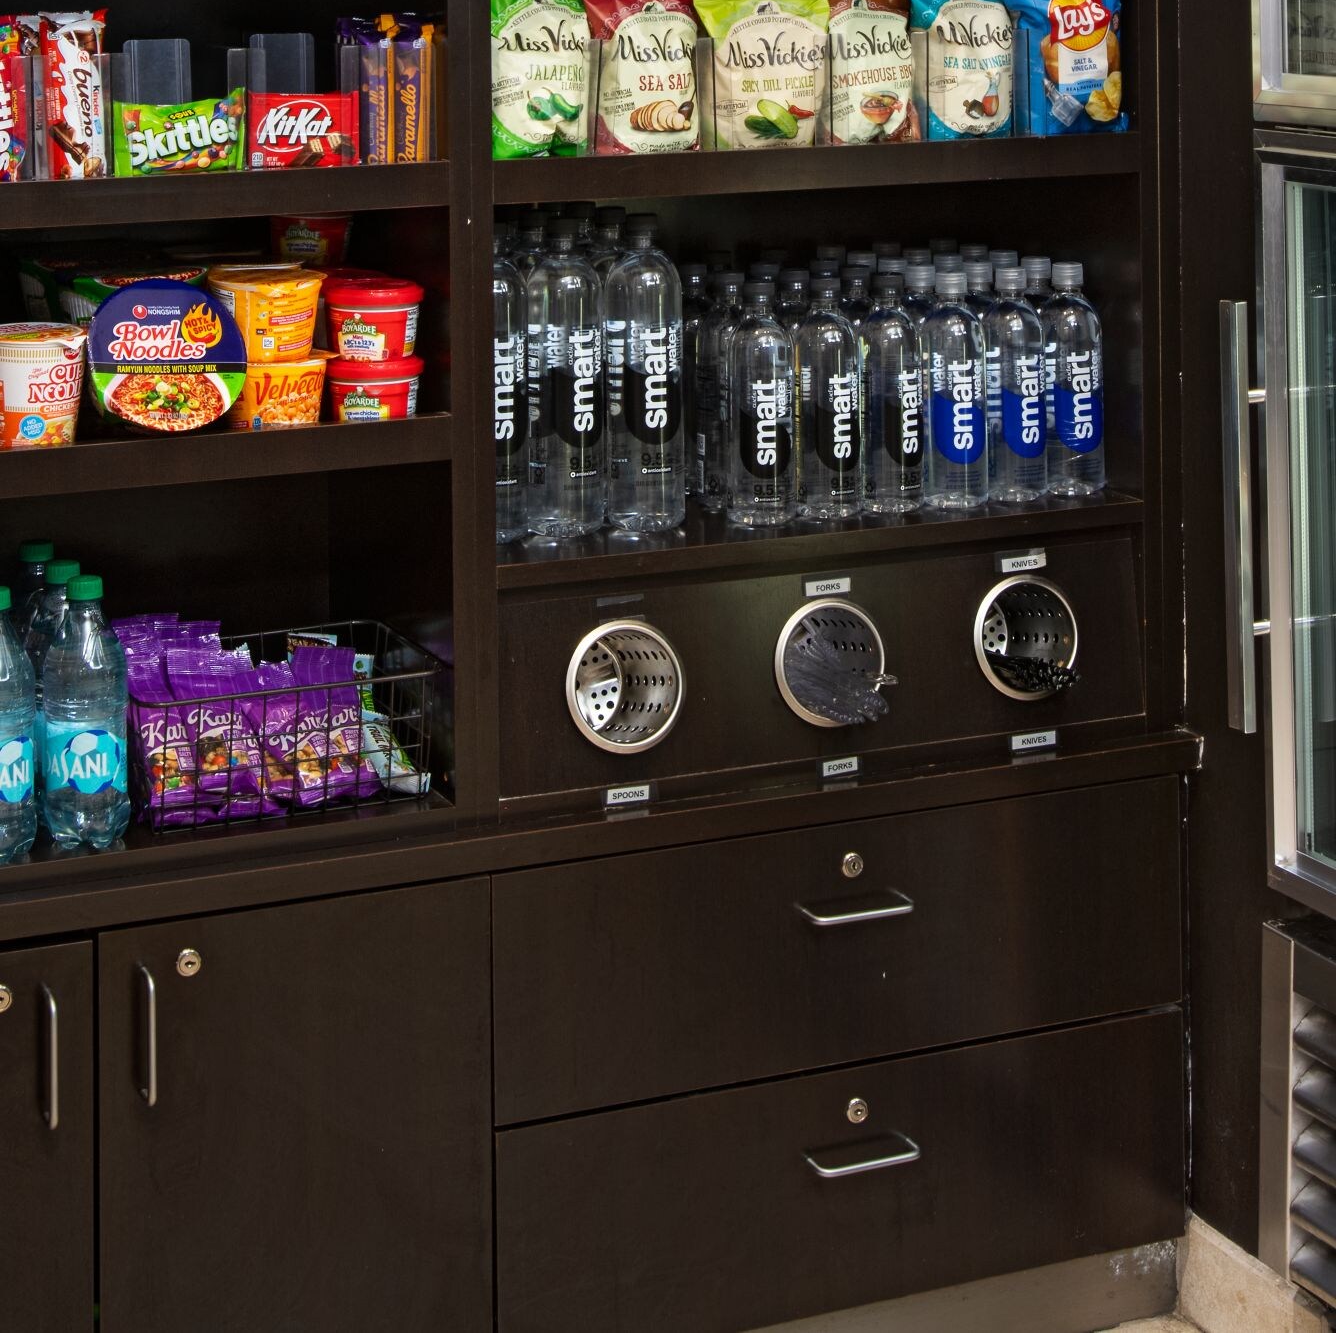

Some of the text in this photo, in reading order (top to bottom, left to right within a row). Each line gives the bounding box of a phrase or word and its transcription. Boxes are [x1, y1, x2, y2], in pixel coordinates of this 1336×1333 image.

[725, 31, 825, 71] Miss Vickie's
[856, 25, 912, 60] Vickie'
[831, 66, 898, 90] SMOKEHOUSE
[943, 56, 959, 69] SEA
[1071, 64, 1098, 73] VINEGAR
[639, 75, 664, 92] SEA
[763, 78, 782, 92] DILL
[785, 75, 814, 91] PICKLE
[72, 67, 93, 138] bueno
[92, 85, 101, 117] Kinder
[396, 83, 417, 164] Caramello
[127, 115, 239, 167] Skittles
[115, 321, 179, 342] Bowl
[184, 316, 203, 329] HOT
[193, 322, 217, 335] SPICY
[341, 323, 377, 335] BOYARDEE
[109, 340, 205, 359] Noodles
[516, 341, 525, 383] water
[666, 327, 676, 372] water
[117, 364, 217, 374] RAMYUN NOODLES WITH SOUP MIX
[573, 330, 595, 432] smart
[644, 326, 667, 429] smart
[973, 358, 982, 400] water
[343, 396, 380, 408] BOYARDEE
[494, 338, 515, 441] smart
[777, 378, 787, 417] water
[948, 359, 974, 451] smart
[1016, 354, 1041, 444] smart
[1066, 350, 1094, 440] smart
[360, 409, 380, 417] chicken
[753, 379, 776, 466] smart
[829, 372, 852, 459] smart
[899, 368, 919, 455] smart
[1011, 558, 1038, 569] KNIVES
[815, 582, 841, 592] FORKS
[1021, 735, 1047, 746] KNIVES
[47, 748, 110, 785] ASANI
[827, 761, 853, 773] FORKS
[611, 789, 645, 801] SPOONS
